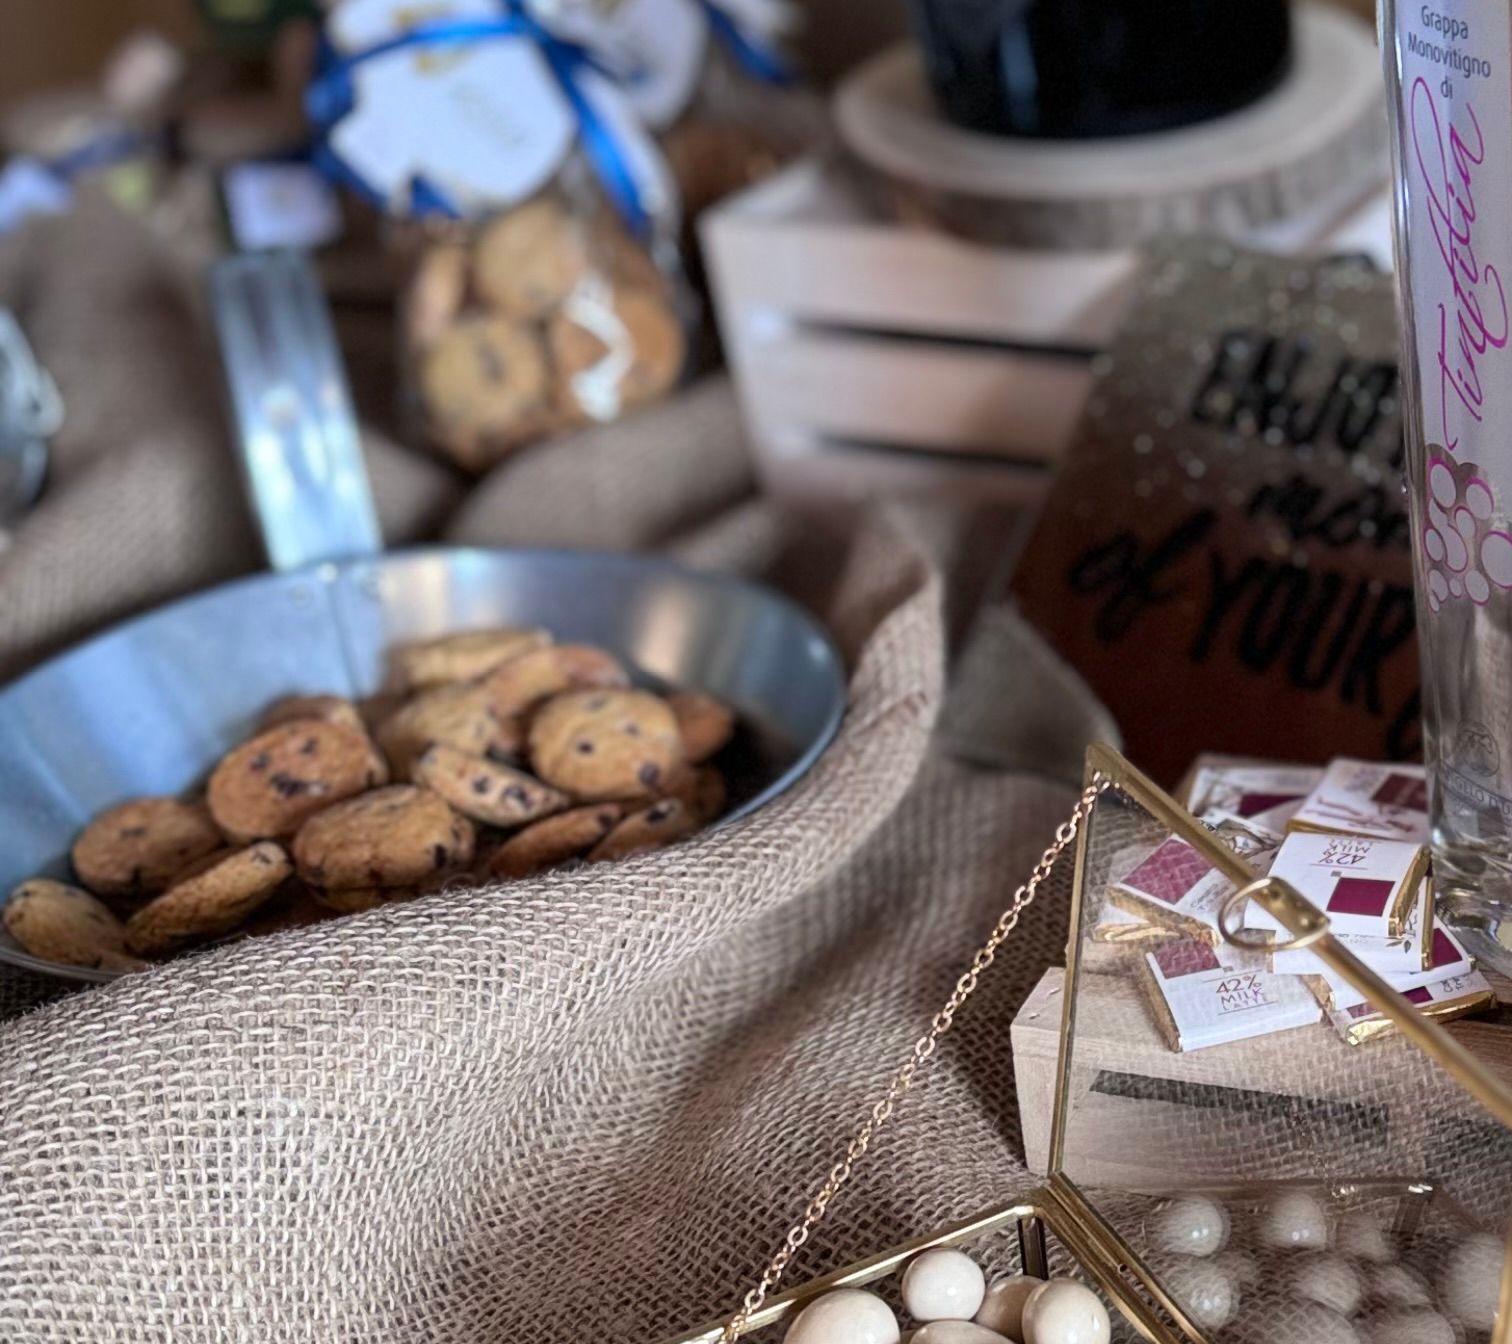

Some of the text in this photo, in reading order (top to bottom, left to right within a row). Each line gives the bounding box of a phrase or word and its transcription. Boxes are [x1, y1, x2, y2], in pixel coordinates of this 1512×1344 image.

[1421, 5, 1469, 41] Grappa
[1408, 31, 1491, 79] Monovitigno
[1440, 76, 1453, 99] di
[1318, 848, 1367, 865] 42%
[1215, 974, 1263, 994] 42%
[1221, 987, 1265, 1003] MILK
